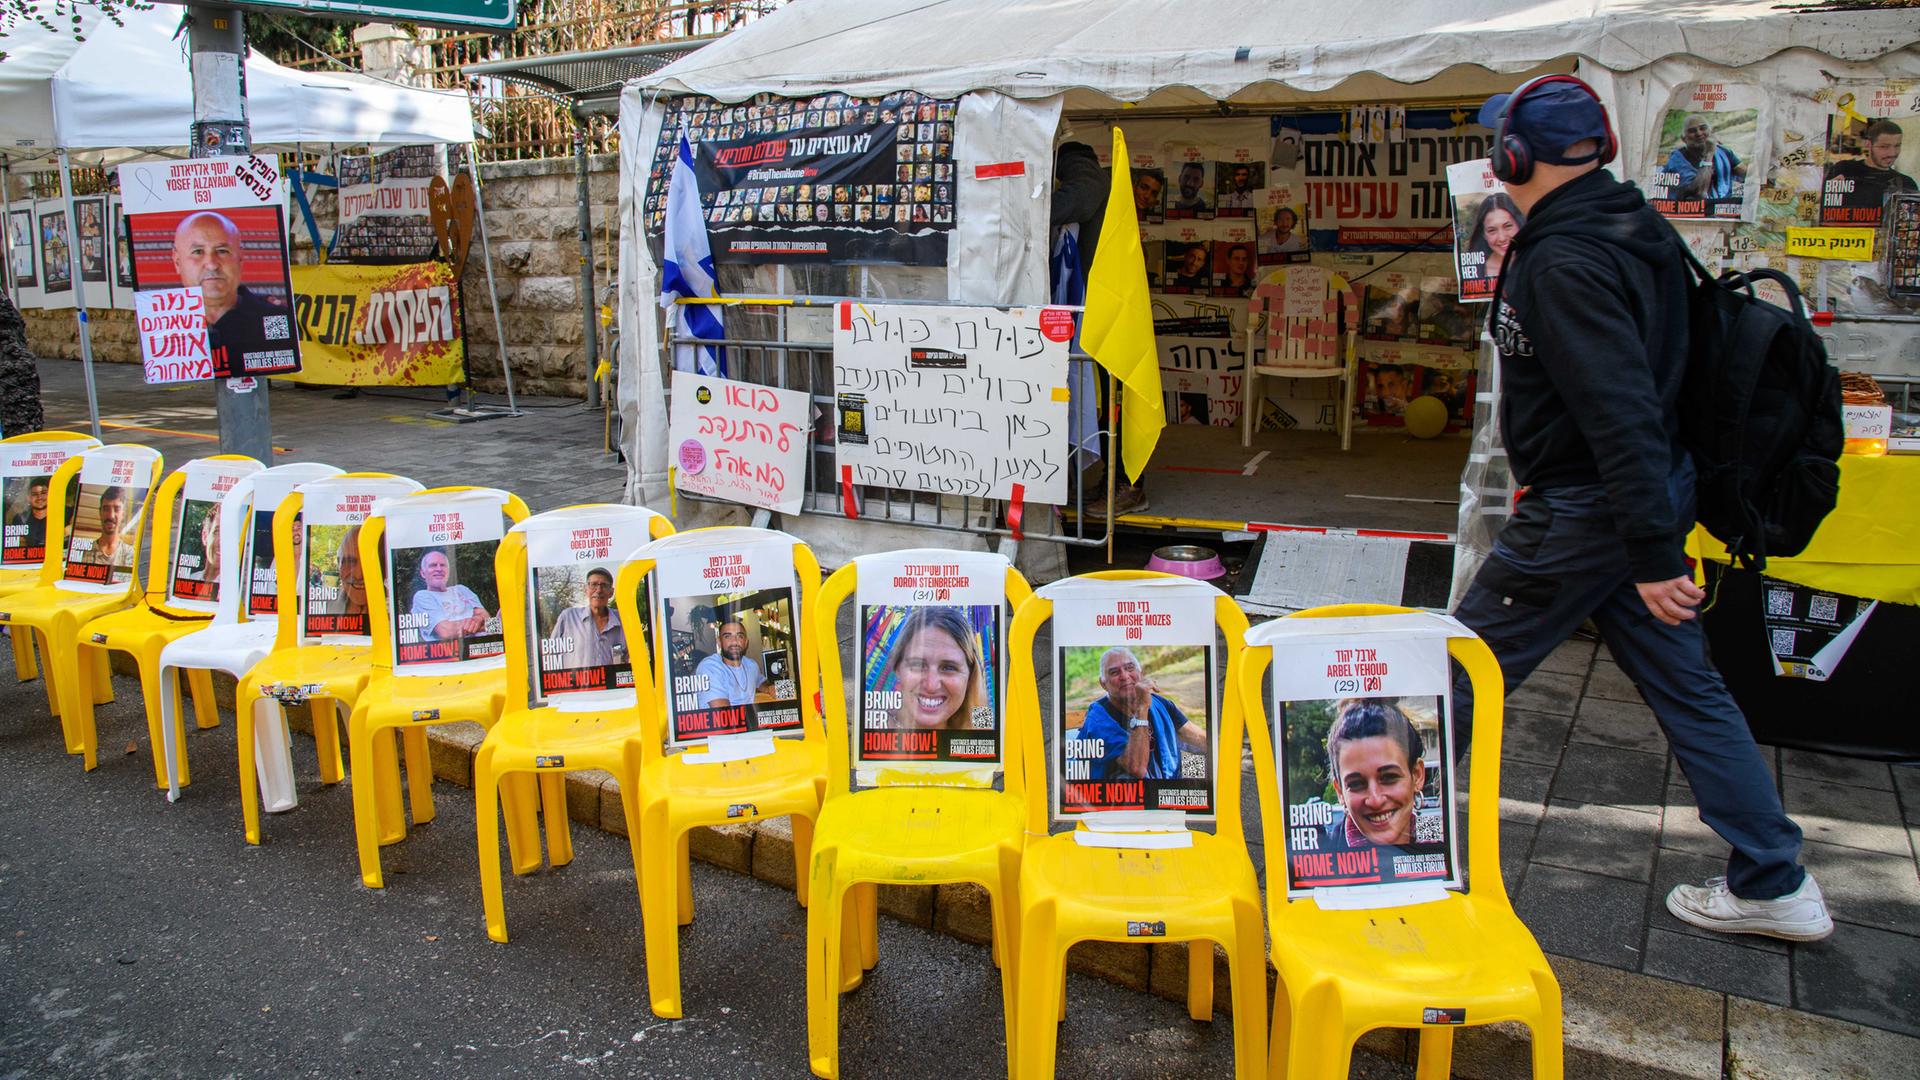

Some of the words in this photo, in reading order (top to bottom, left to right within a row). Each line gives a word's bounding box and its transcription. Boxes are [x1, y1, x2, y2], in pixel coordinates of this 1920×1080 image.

[789, 137, 806, 157] עד
[808, 136, 850, 156] עוצרים
[852, 134, 872, 153] לא
[1305, 139, 1377, 178] אותם
[1783, 149, 1807, 166] 328
[211, 162, 229, 175] יוסף
[166, 178, 191, 191] YOSEF
[194, 175, 236, 189] ALZAYADNI
[1653, 173, 1680, 186] BRING
[1825, 180, 1855, 193] BRING
[194, 190, 212, 204] (53)
[1824, 194, 1843, 206] HIM
[1678, 199, 1705, 213] NOW!
[1823, 207, 1850, 221] HOME
[1852, 207, 1882, 221] NOW!
[1792, 237, 1826, 248] בעזה
[1830, 238, 1866, 250] תינוק
[1460, 251, 1485, 266] BRING
[1461, 266, 1478, 279] HER
[1463, 280, 1487, 294] HOME
[152, 289, 203, 311] למה
[141, 314, 207, 332] השארתם
[355, 285, 455, 352] הפקרת.
[852, 310, 931, 344] כולם
[150, 331, 208, 358] אותנו
[955, 317, 1045, 359] כולם
[245, 357, 273, 369] FAMILIES
[273, 355, 295, 367] FORUM
[144, 358, 213, 382] מאחור?
[836, 356, 921, 394] להתנדב
[942, 364, 1042, 404] יכולים
[725, 385, 780, 412] בואו
[875, 400, 989, 432] בירושלים
[1006, 415, 1051, 450] כאן
[874, 437, 975, 471] החטופים
[993, 449, 1059, 486] למען
[857, 464, 907, 486] סרקו
[918, 469, 990, 497] לפרטים
[336, 504, 359, 512] SHLOMO
[5, 525, 29, 537] BRING
[428, 523, 445, 532] KEITH
[447, 521, 464, 531] SIEGEL
[5, 537, 20, 548] HIM
[72, 537, 94, 550] BRING
[431, 533, 449, 542] (65)
[570, 540, 587, 549] ODED
[588, 538, 612, 548] LIFSHITZ
[4, 548, 25, 560] HOME
[69, 550, 84, 562] HIM
[179, 554, 200, 567] BRING
[575, 551, 595, 560] (84)
[729, 554, 743, 565] שגב
[66, 564, 85, 578] HOME
[86, 565, 108, 579] NOW!
[177, 567, 192, 580] HIM
[254, 568, 277, 582] BRING
[703, 567, 724, 579] SEGEV
[725, 565, 750, 577] KALFON
[904, 565, 942, 576] שטיינברכר
[943, 565, 960, 576] דורון
[175, 580, 194, 594] HOME
[252, 582, 268, 594] HIM
[710, 578, 730, 590] (26)
[893, 577, 917, 588] DORON
[919, 576, 969, 588] STEINBRECHER
[309, 587, 337, 600] BRING
[913, 590, 934, 601] (31)
[251, 596, 272, 610] HOME
[309, 601, 327, 614] HIM
[1117, 601, 1136, 613] מוזס
[1137, 601, 1150, 613] גדי
[308, 616, 335, 630] HOME
[337, 615, 363, 629] NOW!
[399, 613, 429, 628] BRING
[1096, 614, 1115, 626] GADI
[1116, 614, 1143, 626] MOSHE
[1145, 614, 1171, 626] MOZES
[399, 629, 419, 645] HIM
[1125, 627, 1143, 640] (80)
[400, 644, 429, 661] HOME
[430, 640, 459, 657] NOW!
[542, 637, 574, 654] BRING
[1336, 649, 1353, 663] יהוד
[1354, 648, 1377, 662] ארבל
[542, 654, 563, 671] HIM
[1327, 664, 1352, 677] ARBEL
[1354, 663, 1388, 676] YEHOUD
[543, 671, 574, 689] HOME
[576, 667, 606, 688] NOW!
[675, 674, 710, 694] BRING
[1334, 680, 1360, 693] (29)
[676, 694, 699, 712] HIM
[865, 690, 902, 710] BRING
[677, 712, 710, 731] HOME
[712, 706, 746, 728] NOW!
[864, 710, 889, 730] HER
[864, 732, 898, 751] HOME
[902, 731, 937, 752] NOW!
[1065, 739, 1104, 759] BRING
[1065, 760, 1090, 780] HIM
[1065, 783, 1102, 803] HOME
[1106, 780, 1144, 803] NOW!
[1158, 796, 1185, 806] FAMILIES
[1186, 796, 1208, 806] FORUM
[1289, 803, 1332, 826] BRING
[1291, 828, 1319, 850] HER
[1293, 853, 1334, 877] HOME
[1337, 848, 1379, 875] NOW!
[1394, 863, 1422, 874] FAMILIES
[1424, 862, 1446, 873] FORUM
